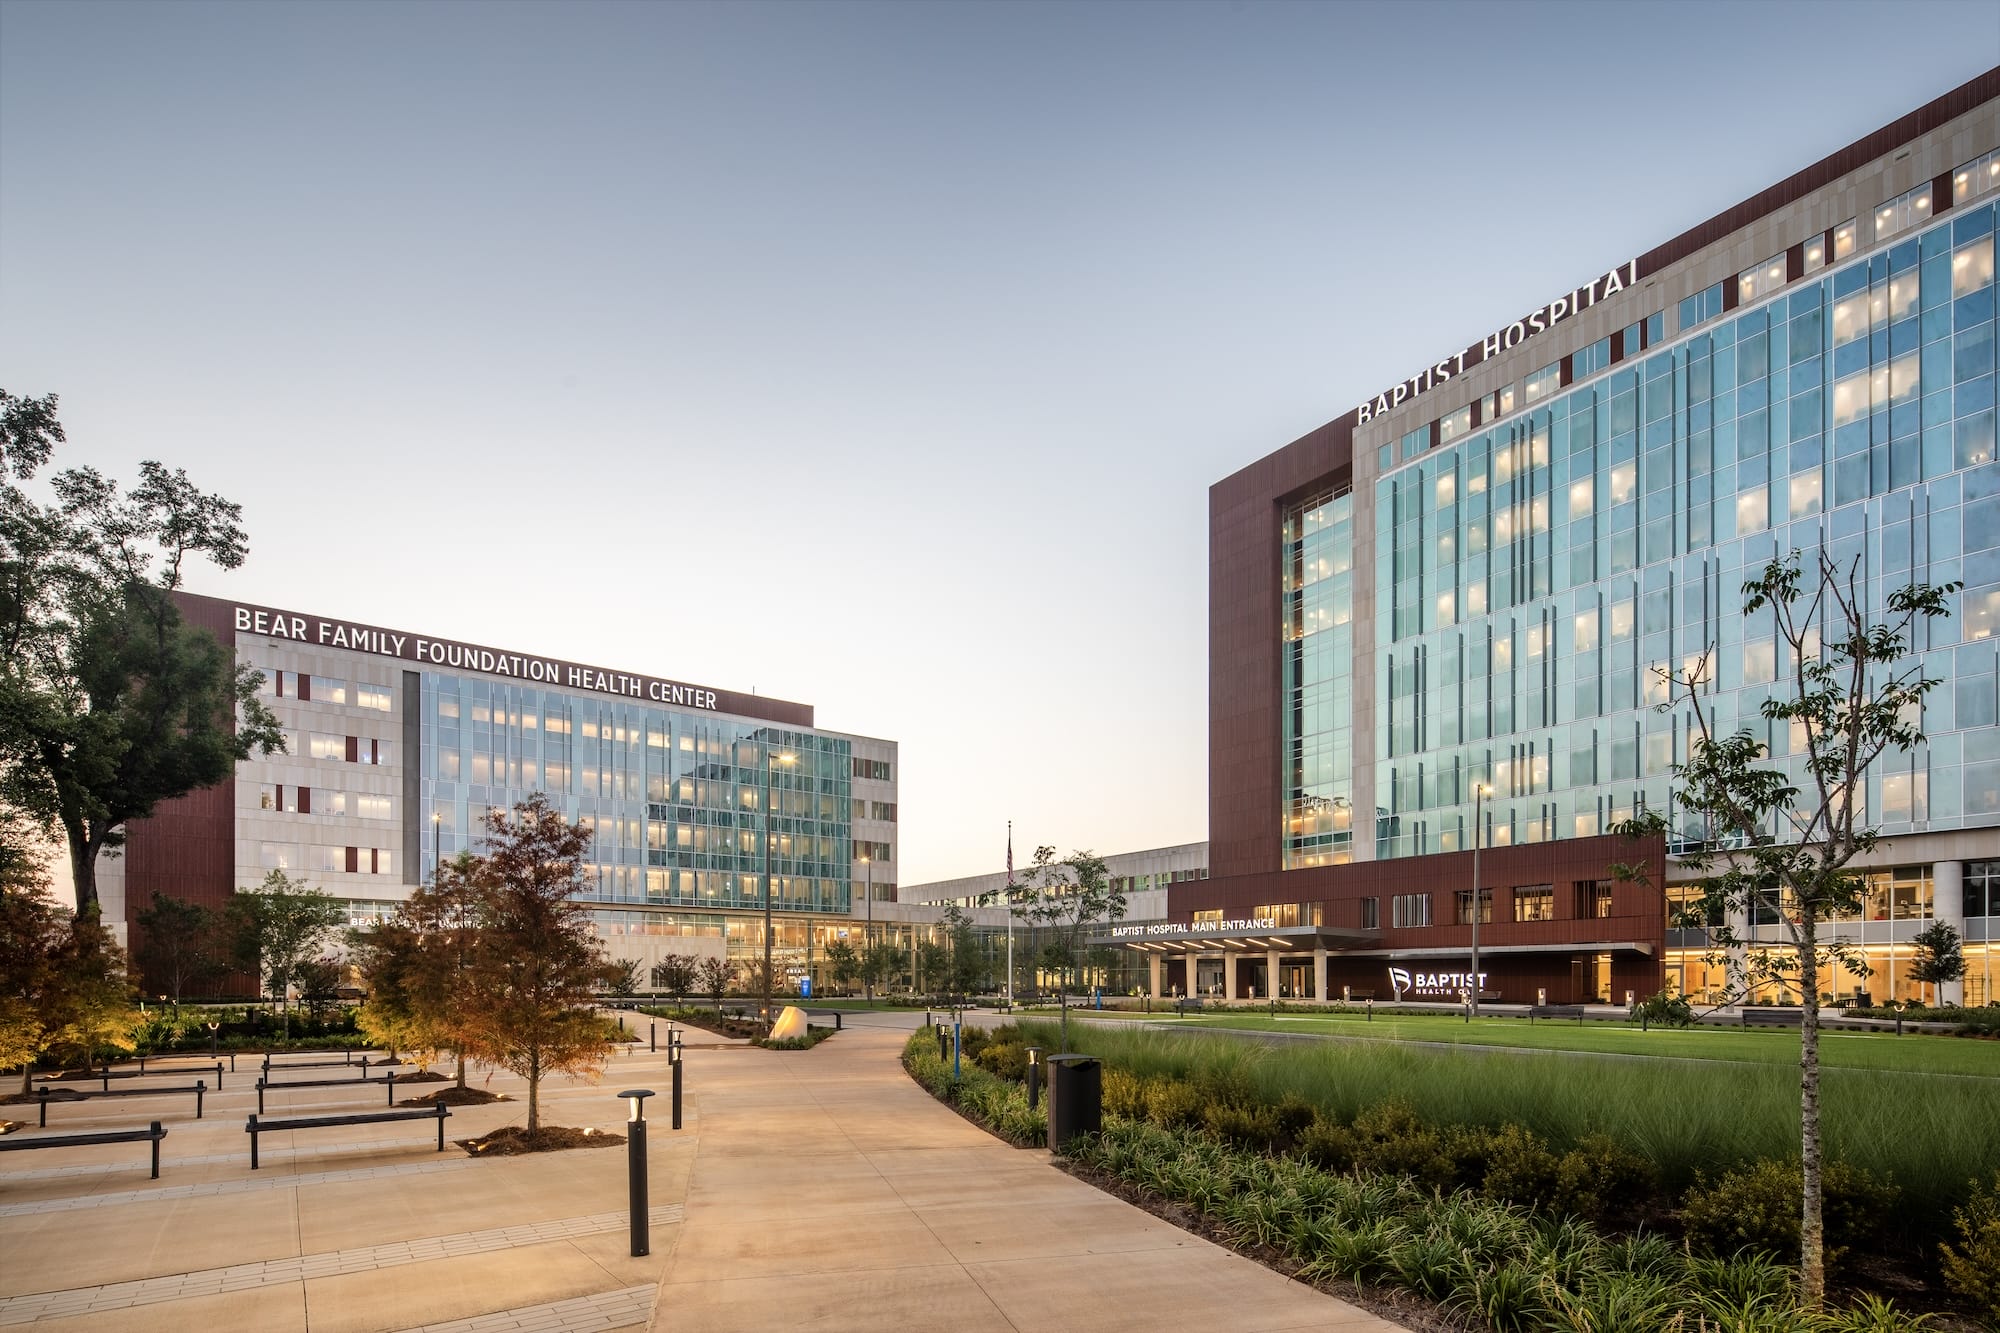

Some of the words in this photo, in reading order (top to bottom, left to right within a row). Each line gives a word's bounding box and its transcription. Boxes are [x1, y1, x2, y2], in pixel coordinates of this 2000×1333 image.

[1358, 349, 1468, 426] BAPTIST
[235, 607, 307, 641] BEAR
[319, 622, 406, 657] FAMILY
[416, 639, 560, 684] FOUNDATION
[568, 666, 642, 698] HEALTH
[649, 681, 717, 710] CENTER
[1112, 925, 1144, 937] BAPTIST
[1147, 922, 1188, 935] HOSPITAL
[1191, 920, 1217, 933] MAIN
[1220, 917, 1275, 931] ENTRANCE
[1415, 973, 1487, 988] BAPTIST
